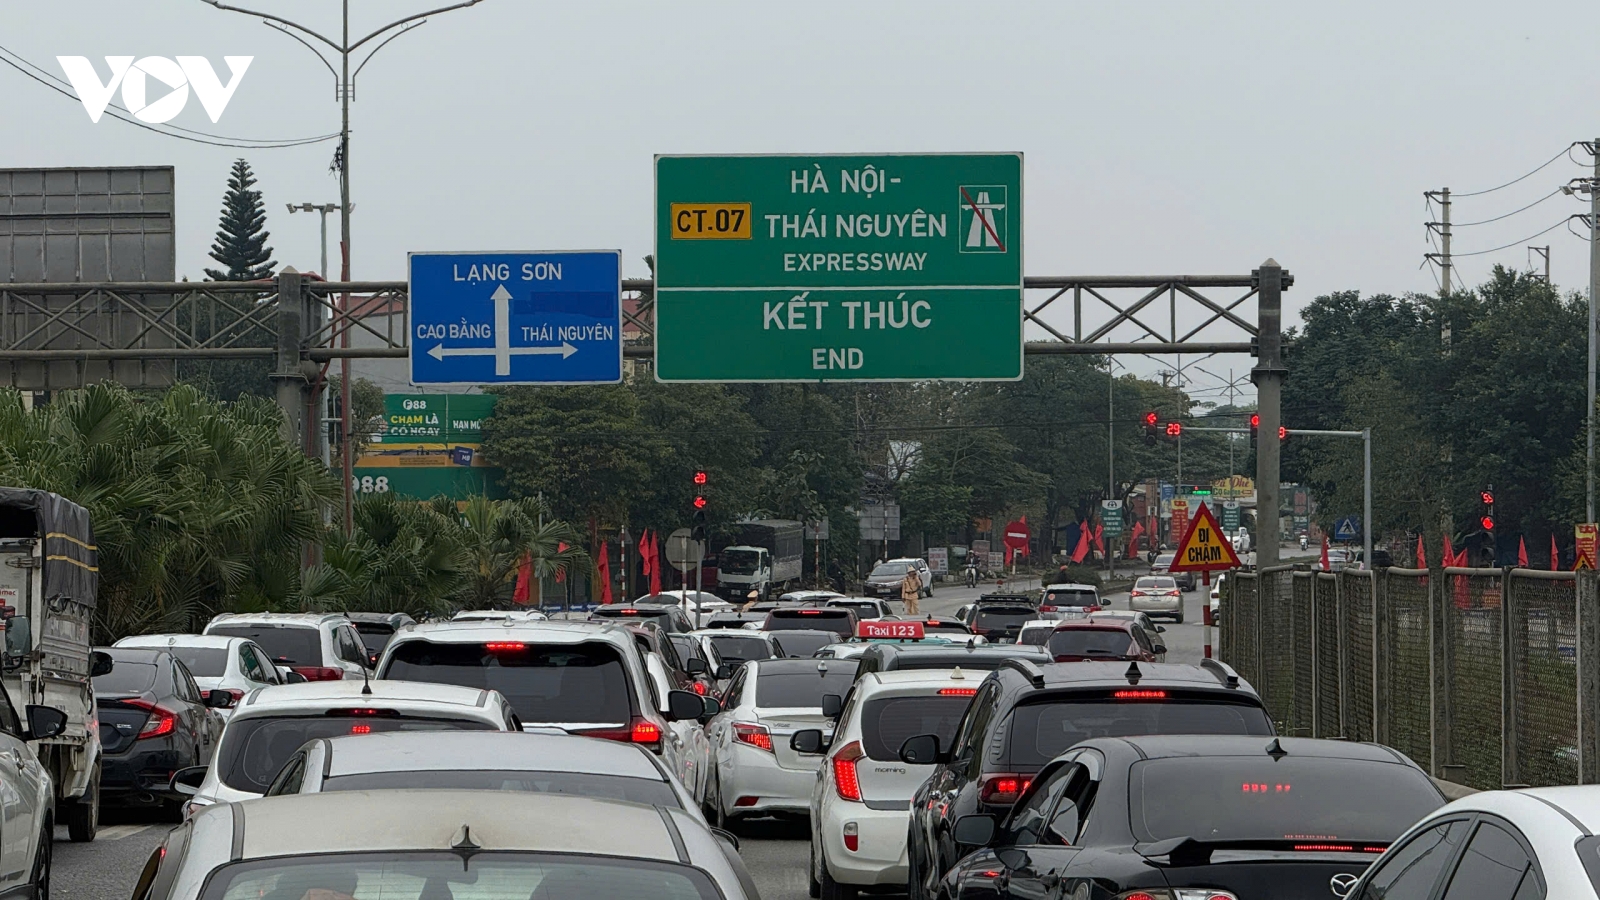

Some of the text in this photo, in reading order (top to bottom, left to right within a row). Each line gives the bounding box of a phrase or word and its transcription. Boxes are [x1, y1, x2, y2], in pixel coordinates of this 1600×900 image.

[791, 164, 829, 194] HÀ
[676, 209, 745, 233] CT.07
[765, 208, 947, 238] THÁI NGUYÊN
[784, 252, 927, 272] EXPRESSWAY
[453, 261, 562, 286] LẠNG SƠN
[763, 292, 931, 330] KẾT THÚC
[416, 317, 492, 339] CAO BẰNG
[521, 322, 613, 341] THÁI NGUYÊN
[812, 348, 864, 370] END
[390, 412, 439, 427] CHẠM LÀ
[453, 420, 469, 432] HẠN
[1166, 423, 1181, 435] 29
[410, 427, 440, 436] NGAY
[1198, 527, 1209, 543] ĐI
[1188, 543, 1222, 564] CHẬM
[867, 625, 889, 636] Taxi
